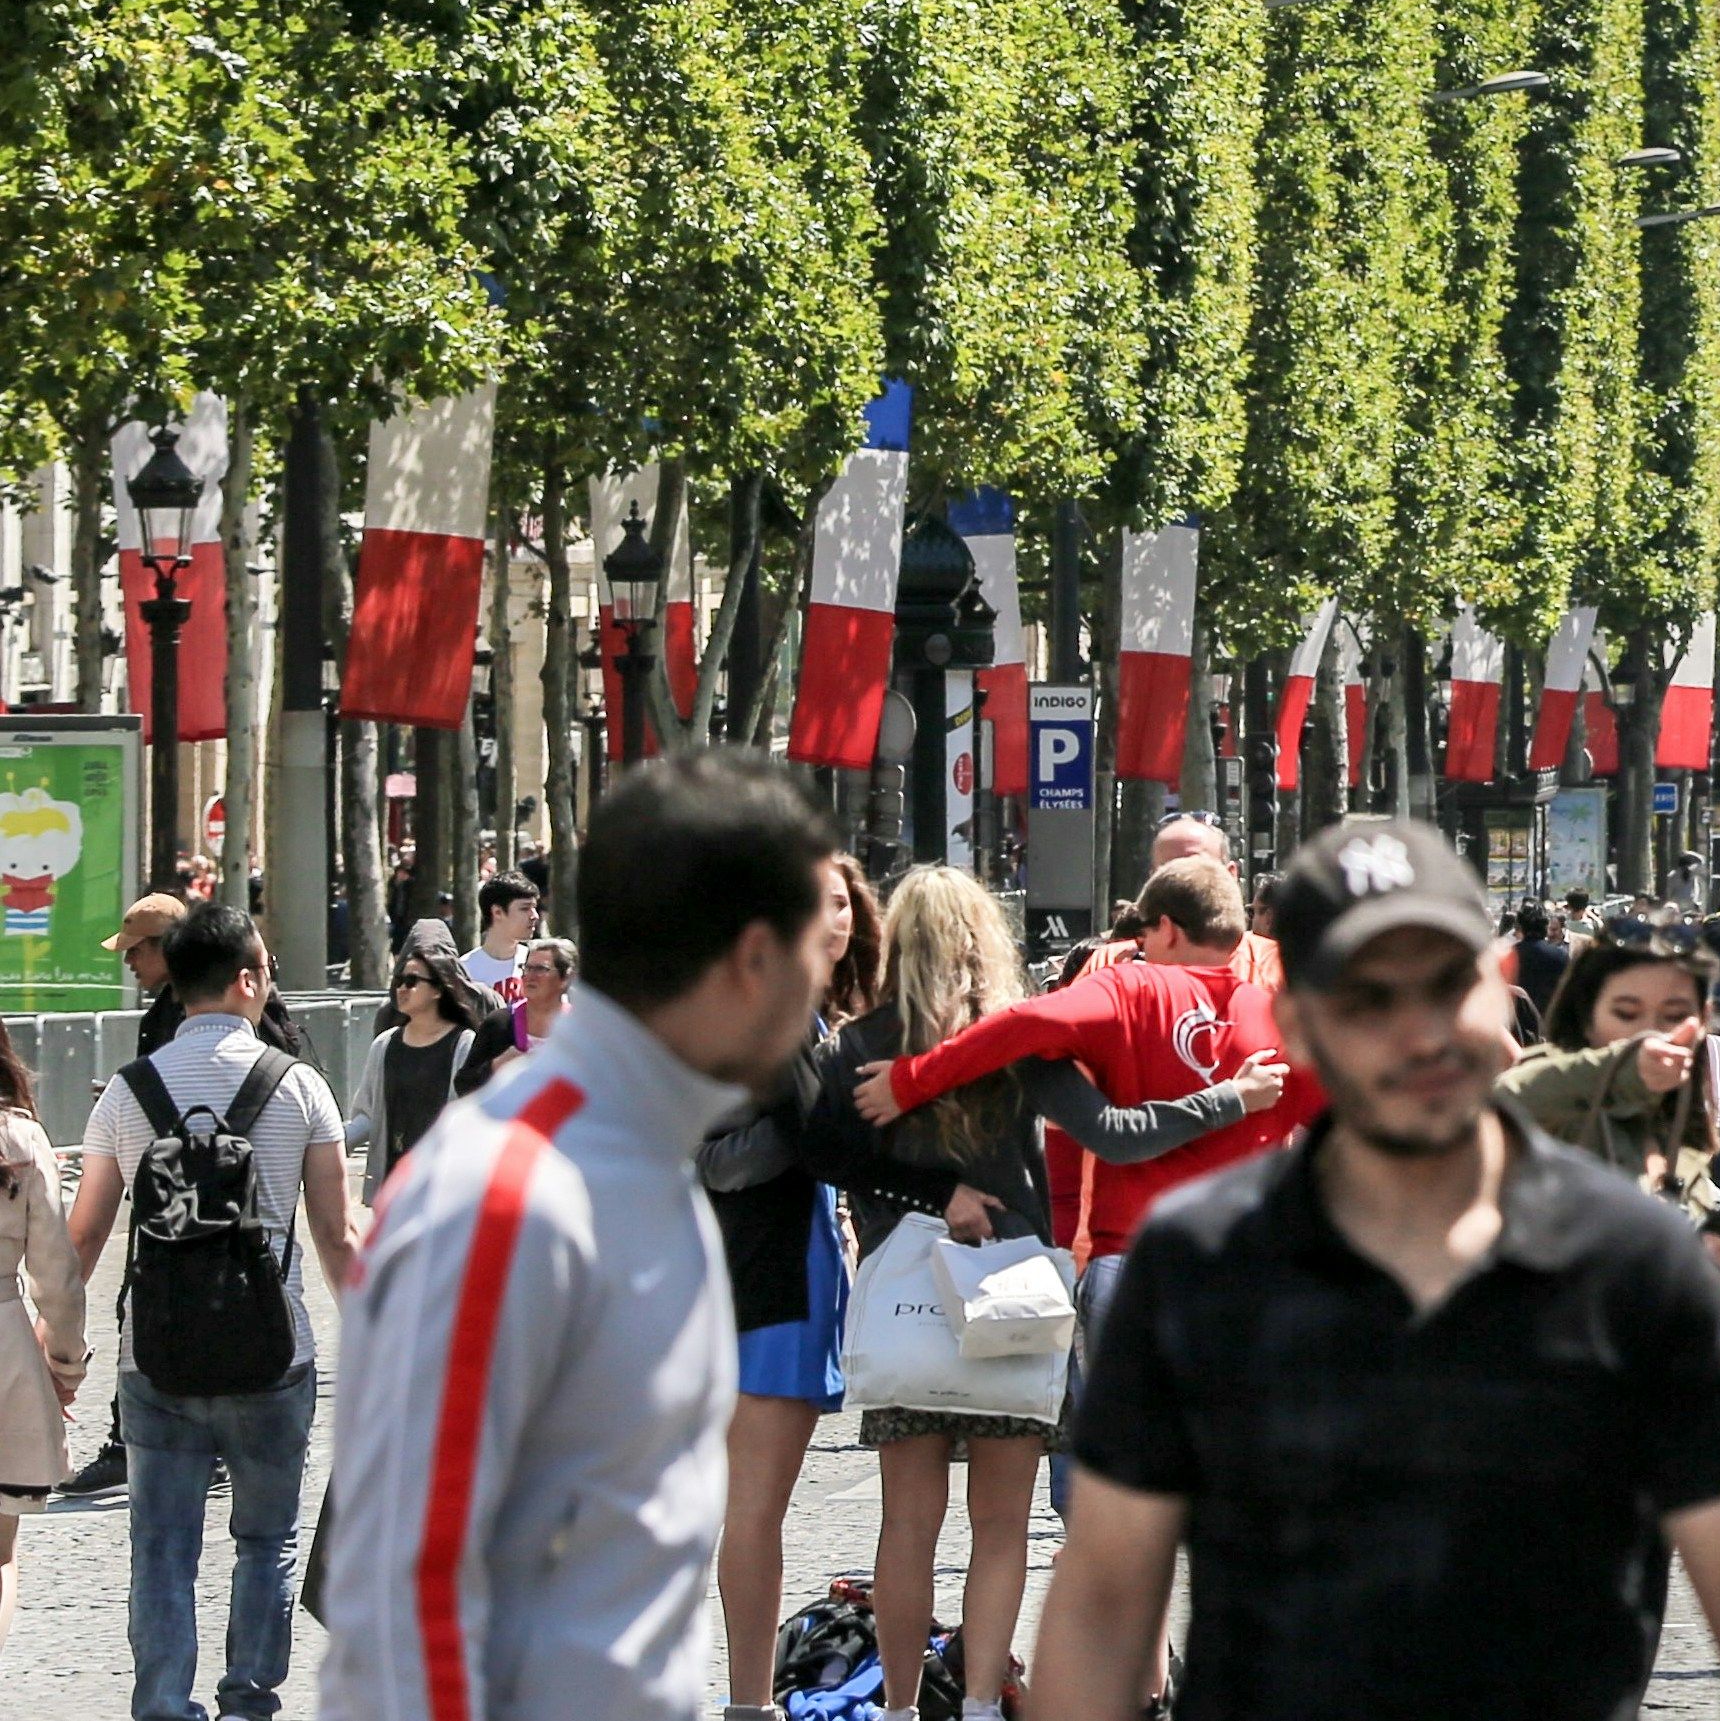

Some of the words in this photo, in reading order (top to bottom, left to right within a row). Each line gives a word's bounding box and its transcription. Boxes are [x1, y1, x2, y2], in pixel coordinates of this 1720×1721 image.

[1034, 696, 1086, 709] INDIGO
[1038, 728, 1080, 782] P
[1038, 788, 1084, 798] CHAMPS
[1039, 799, 1084, 810] ÉLYSÉES
